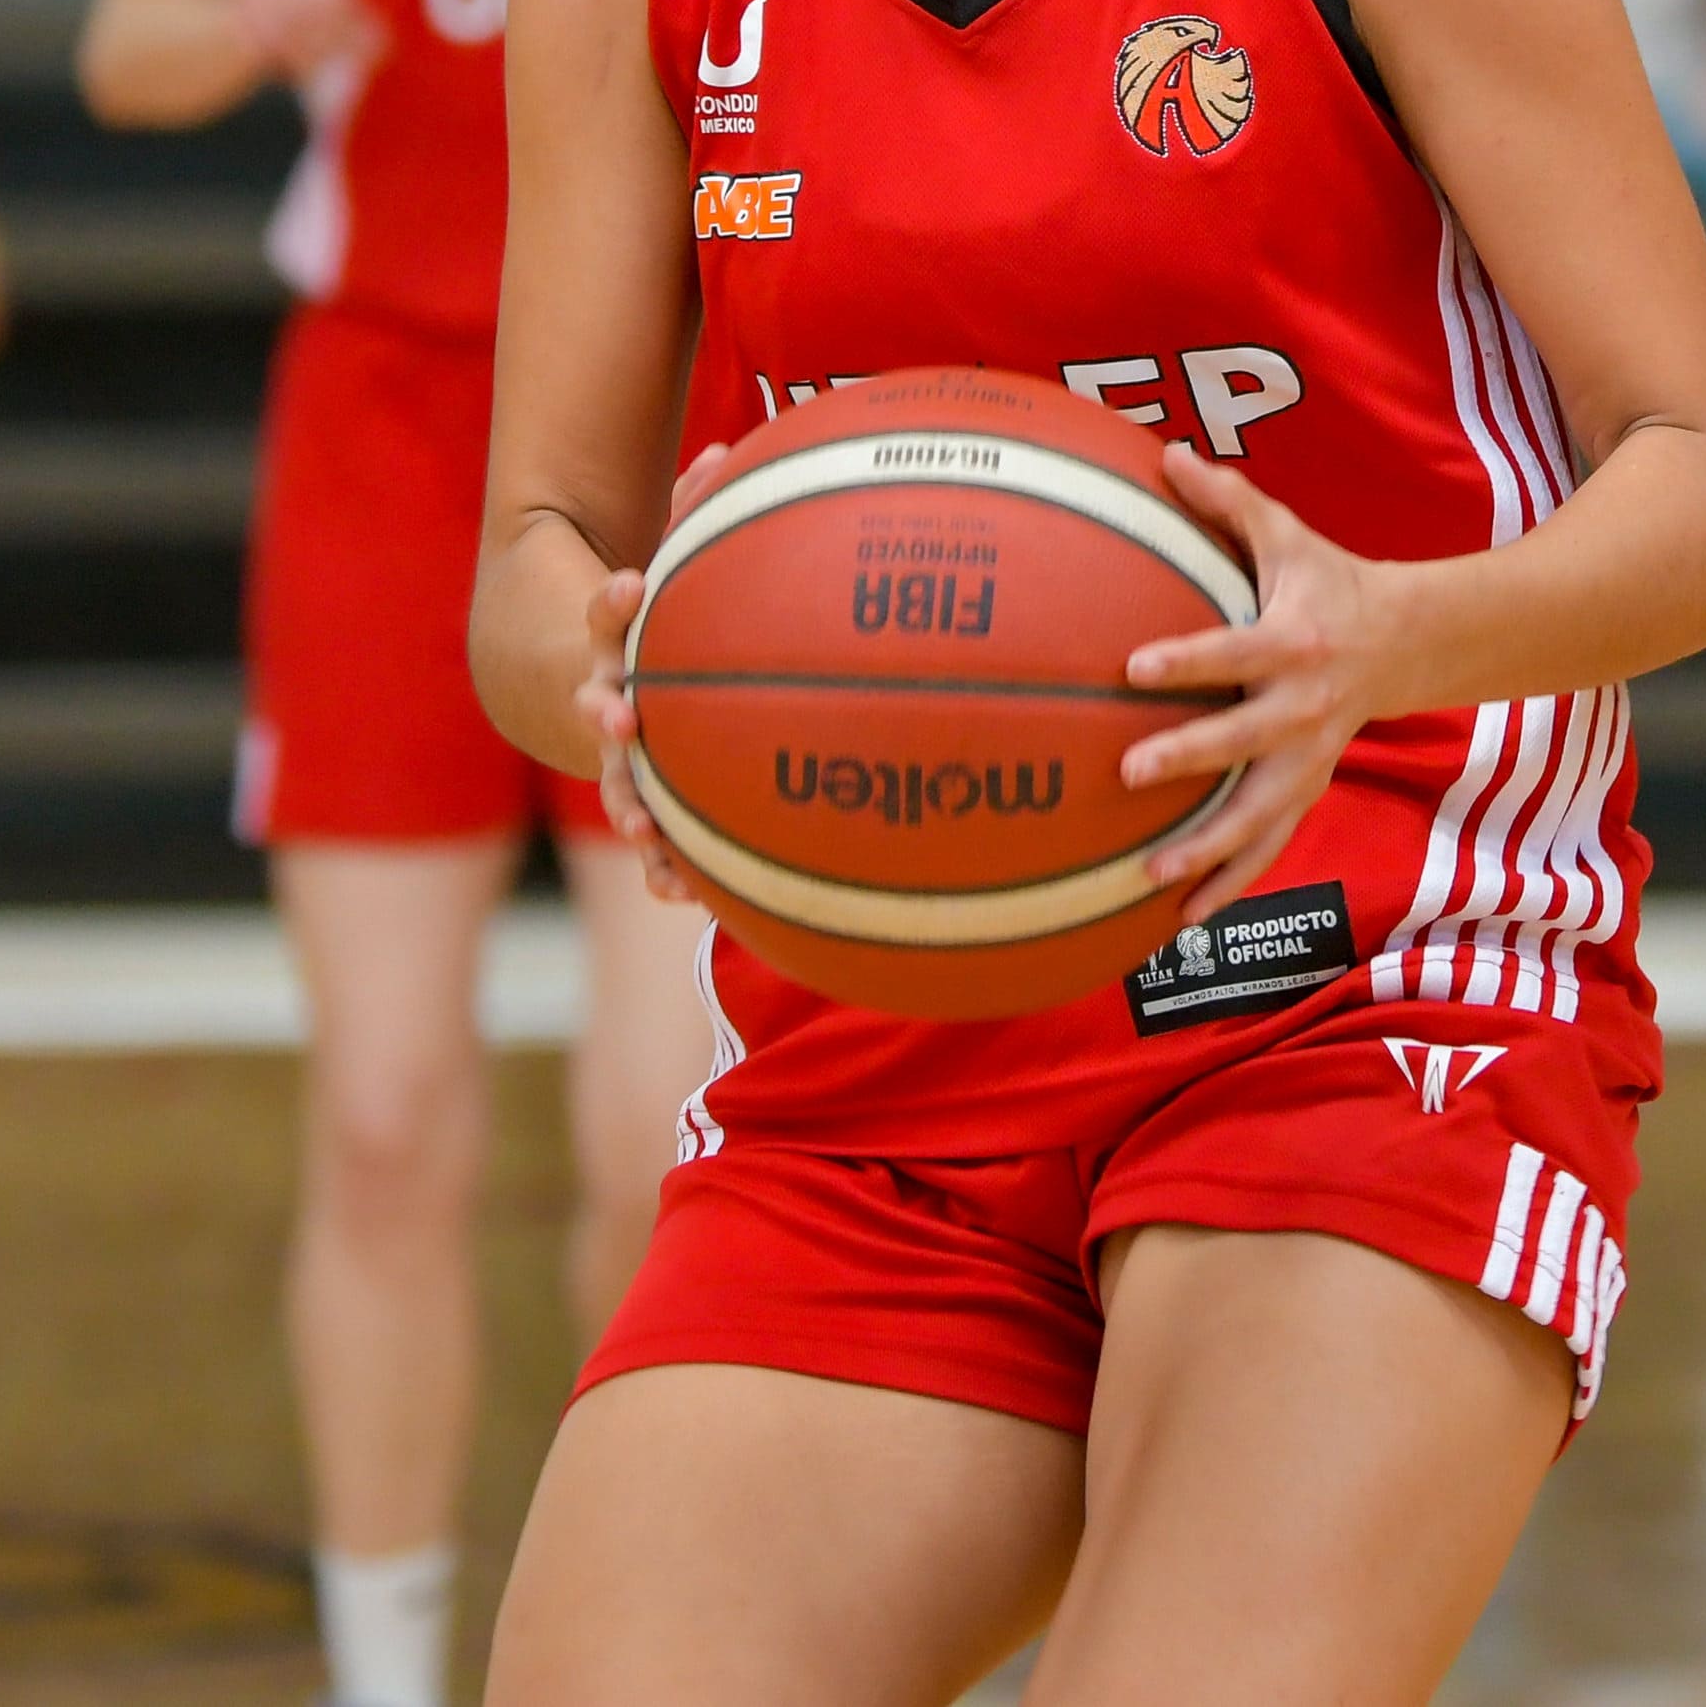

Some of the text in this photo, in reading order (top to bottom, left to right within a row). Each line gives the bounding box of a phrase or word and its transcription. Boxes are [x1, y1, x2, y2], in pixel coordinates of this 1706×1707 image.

[700, 117, 755, 134] MEXICO
[694, 171, 801, 240] ABE
[857, 539, 998, 565] APPROVED
[852, 572, 996, 637] FIBA
[774, 747, 1064, 828] molten
[1224, 909, 1338, 945] PRODUCTO
[1227, 936, 1313, 965] OFICIAL
[1137, 968, 1174, 985] TITAN
[1173, 990, 1213, 1006] VOLAMOS
[1242, 980, 1284, 991] MIRAMOS
[1287, 974, 1317, 986] LEJOS
